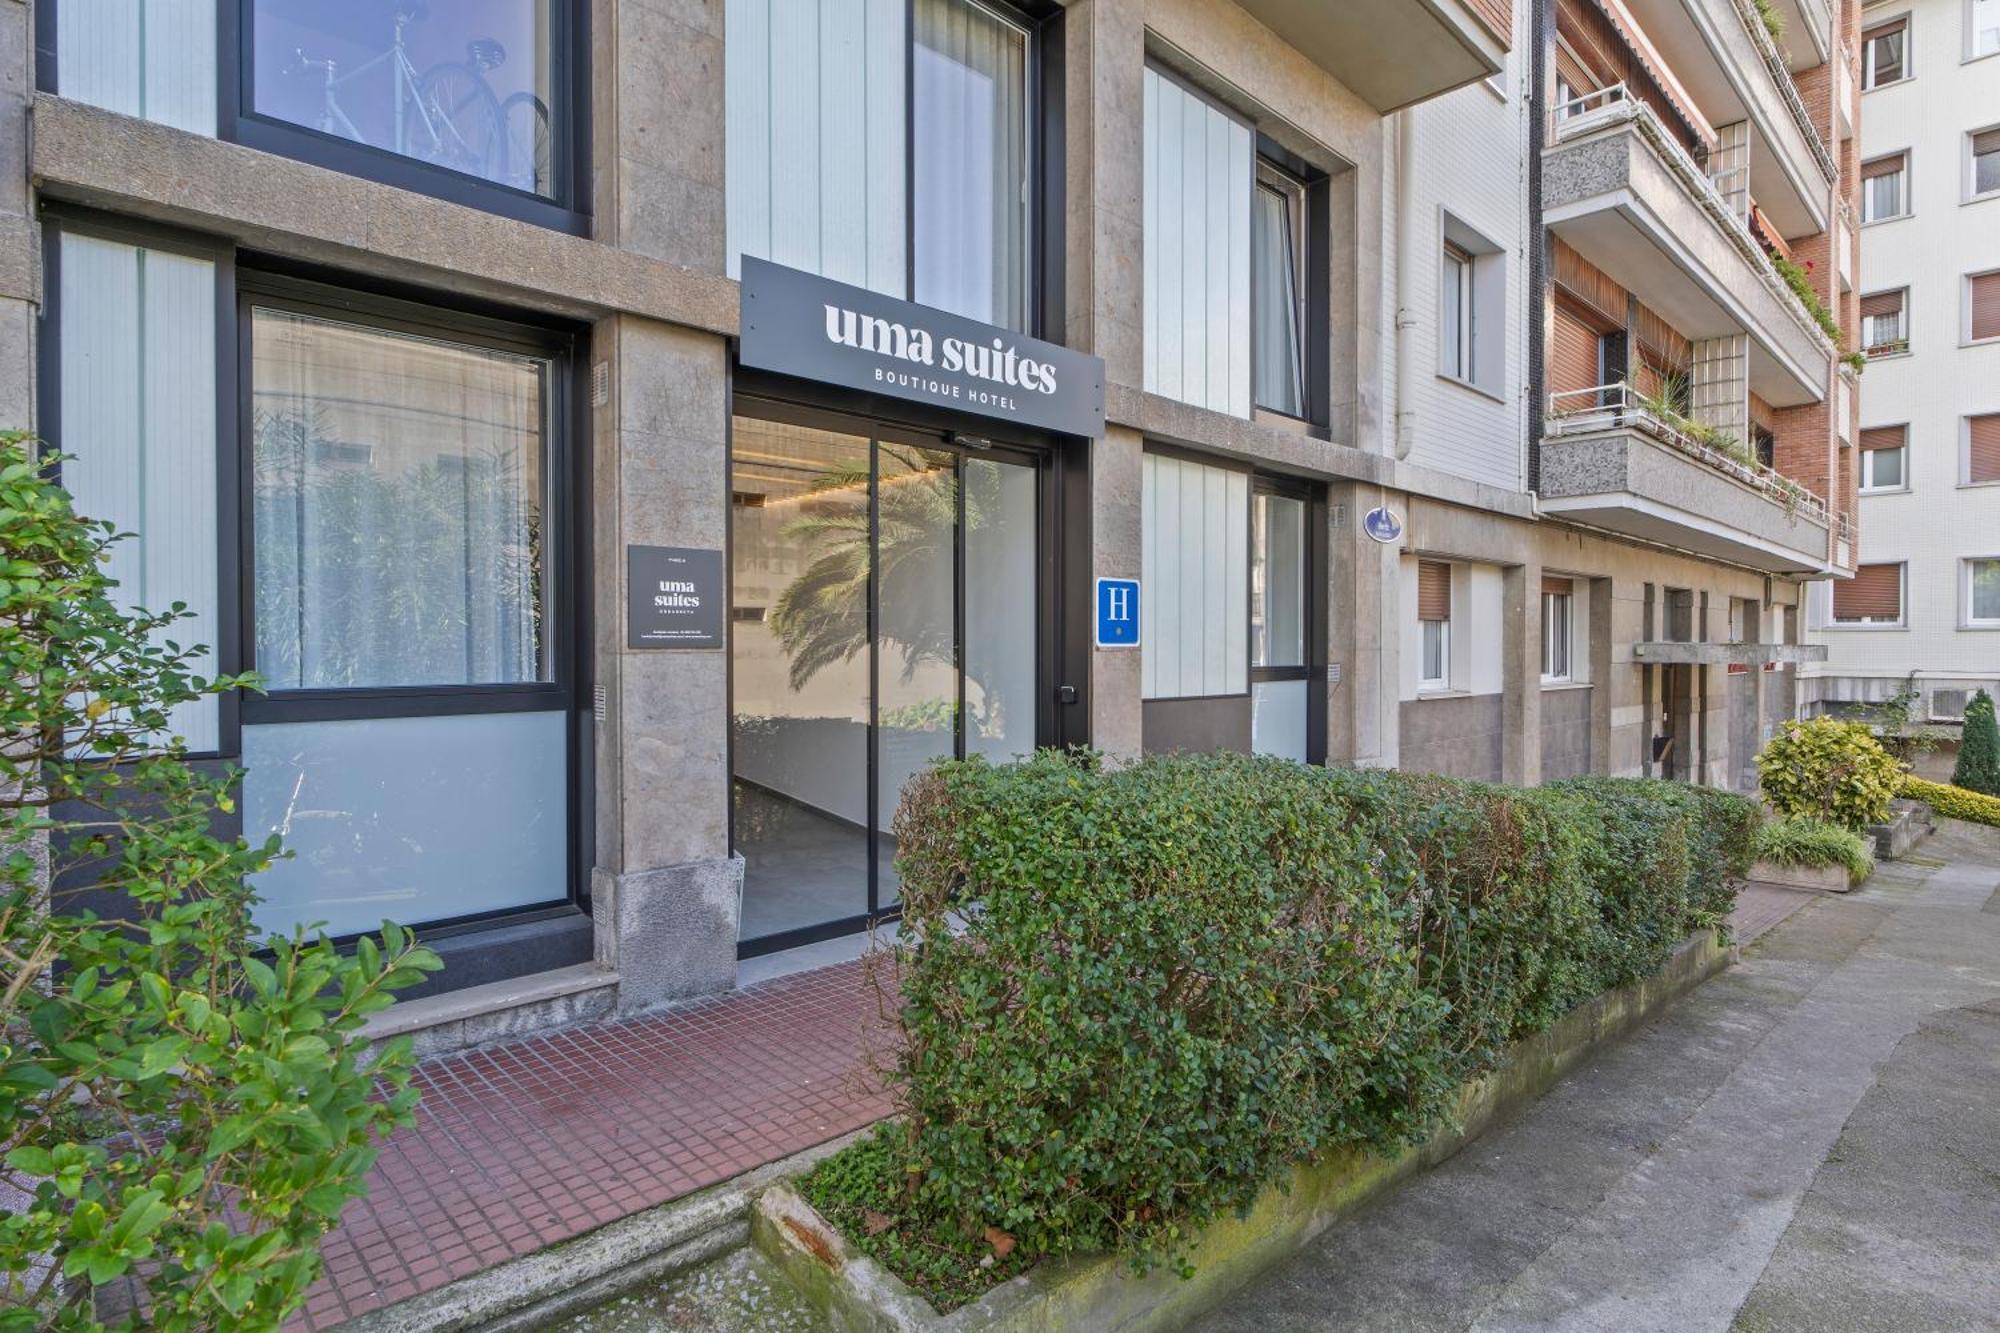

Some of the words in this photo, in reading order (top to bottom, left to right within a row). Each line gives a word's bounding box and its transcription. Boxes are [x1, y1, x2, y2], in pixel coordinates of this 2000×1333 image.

[824, 304, 934, 366] uma
[941, 338, 1057, 394] suites
[875, 368, 960, 398] BOUTIQUE
[969, 391, 1016, 410] HOTEL
[654, 593, 700, 607] suites
[659, 580, 695, 593] uma
[1107, 587, 1130, 621] H
